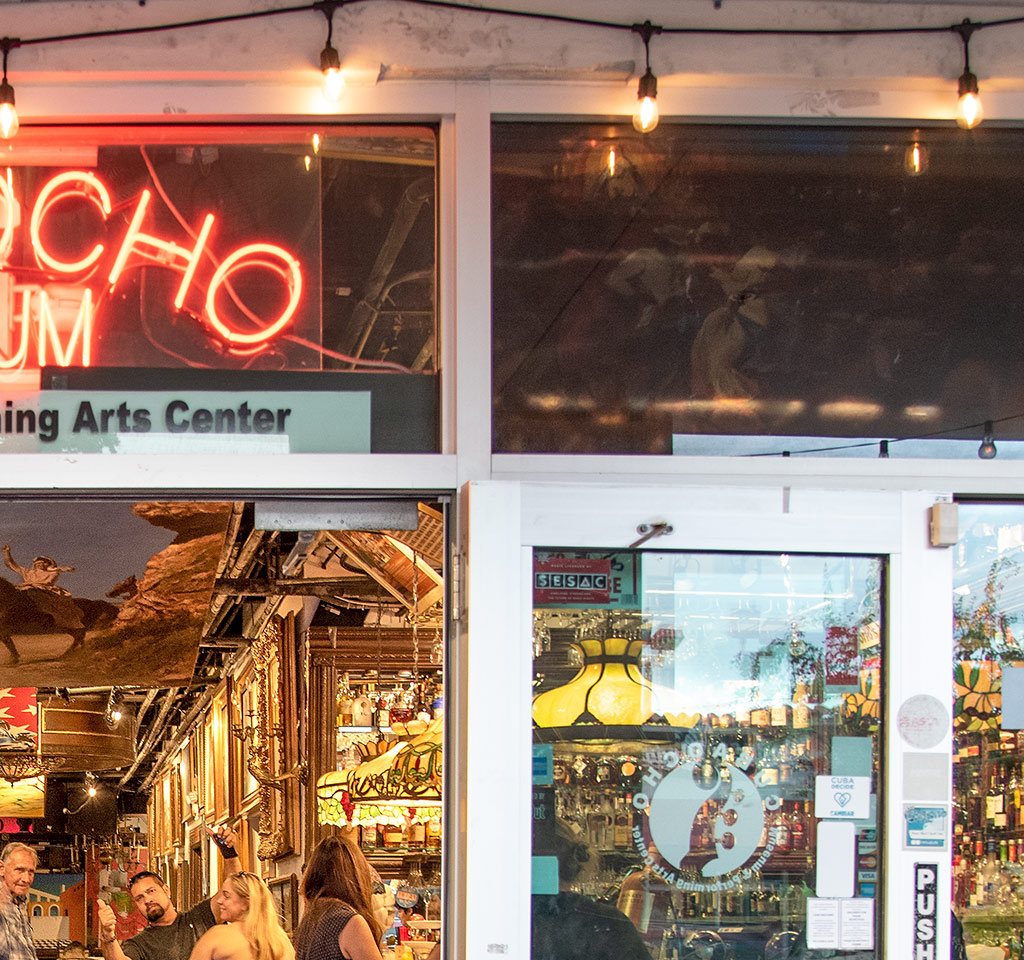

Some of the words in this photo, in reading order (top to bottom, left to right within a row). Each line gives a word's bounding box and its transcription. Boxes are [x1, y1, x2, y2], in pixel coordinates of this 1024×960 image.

[72, 400, 152, 434] Arts
[164, 400, 292, 434] Center
[537, 574, 605, 588] SESAC
[831, 776, 855, 784] CUBA
